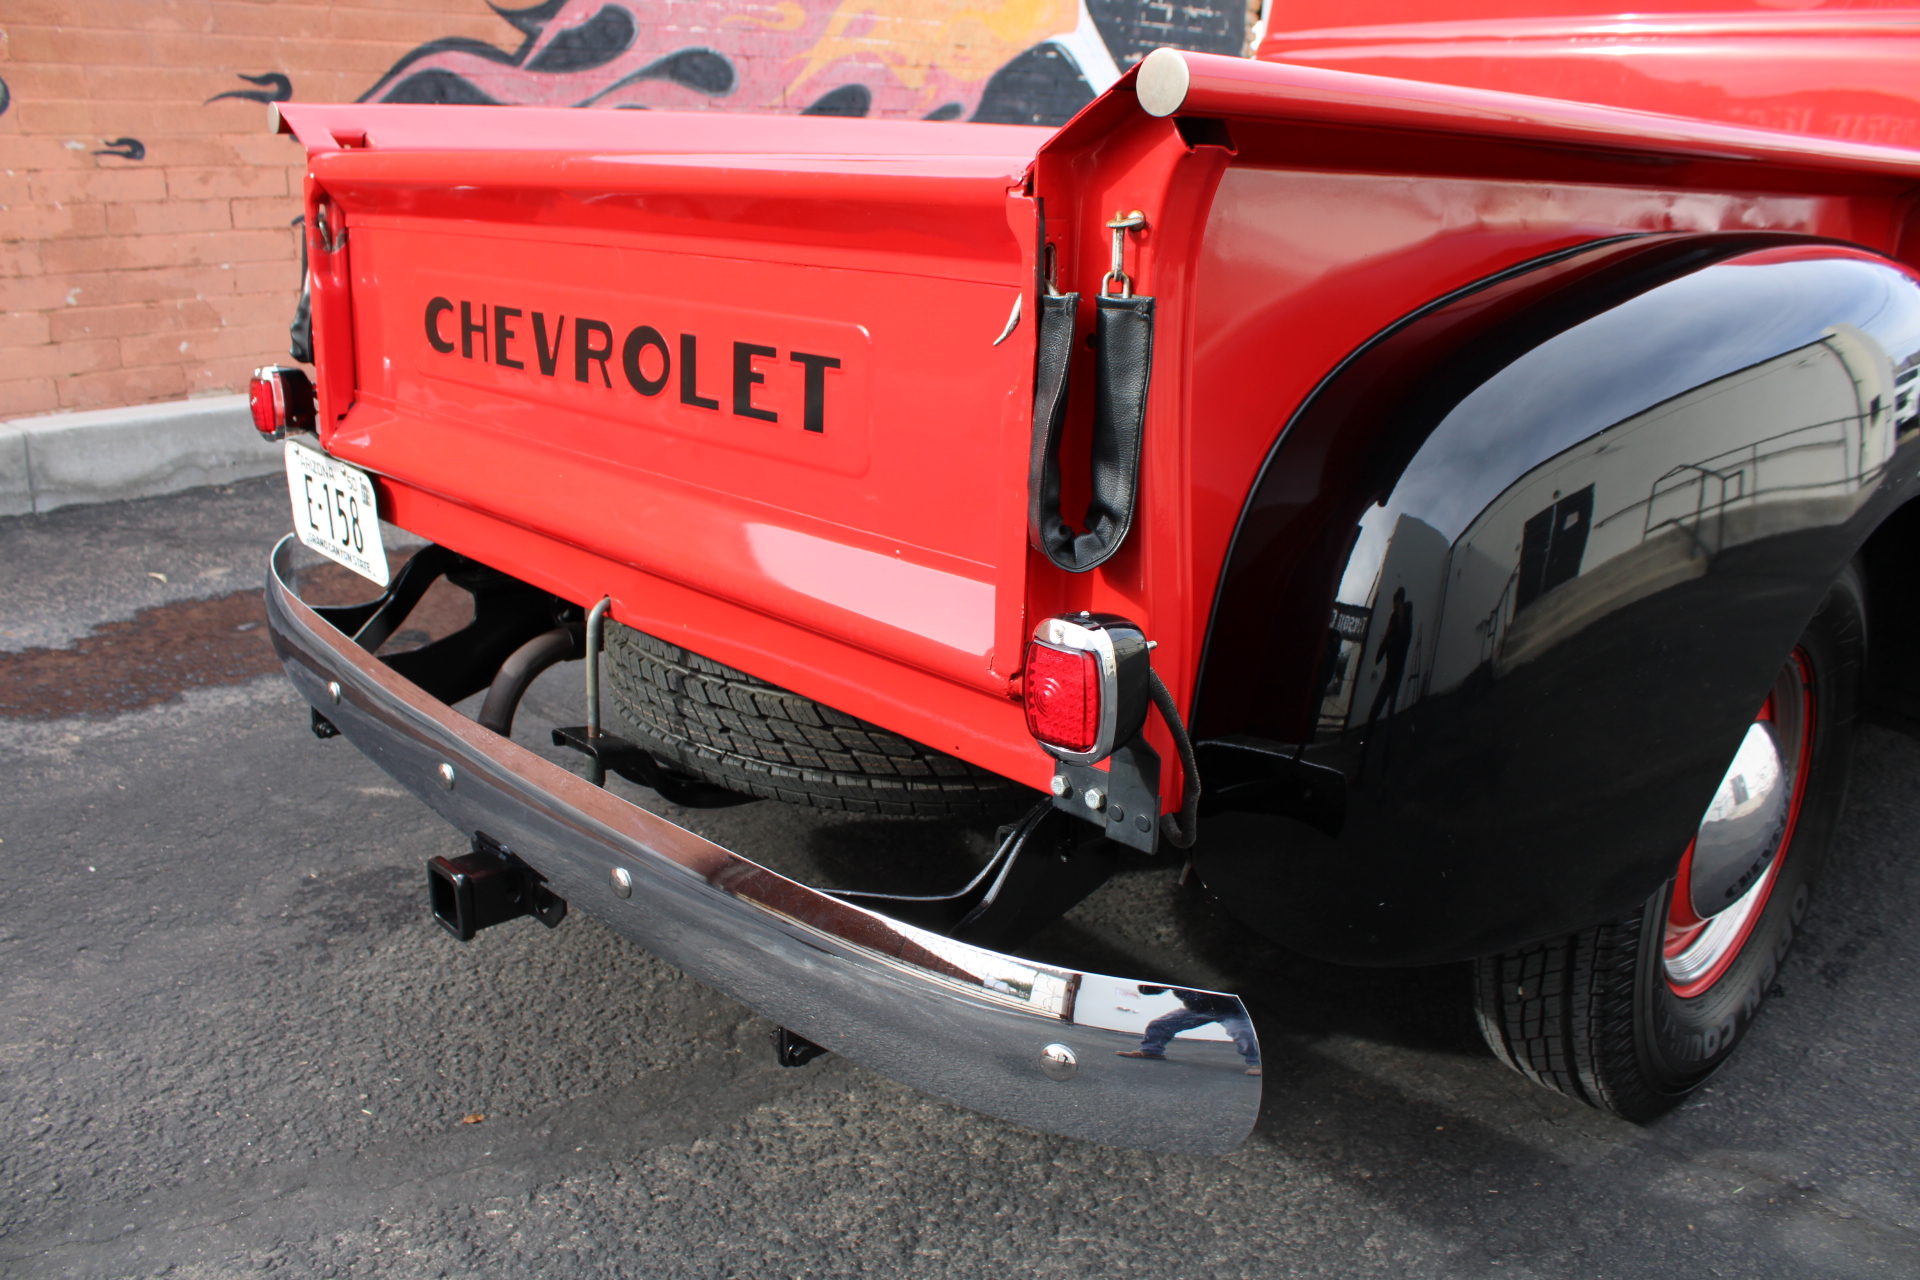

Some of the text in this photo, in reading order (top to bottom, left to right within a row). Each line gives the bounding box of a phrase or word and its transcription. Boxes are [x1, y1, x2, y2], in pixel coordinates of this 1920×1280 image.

[424, 296, 841, 434] CHEVROLET
[300, 456, 335, 482] ARIZONA
[328, 542, 351, 562] CANYON
[351, 556, 372, 574] STATE
